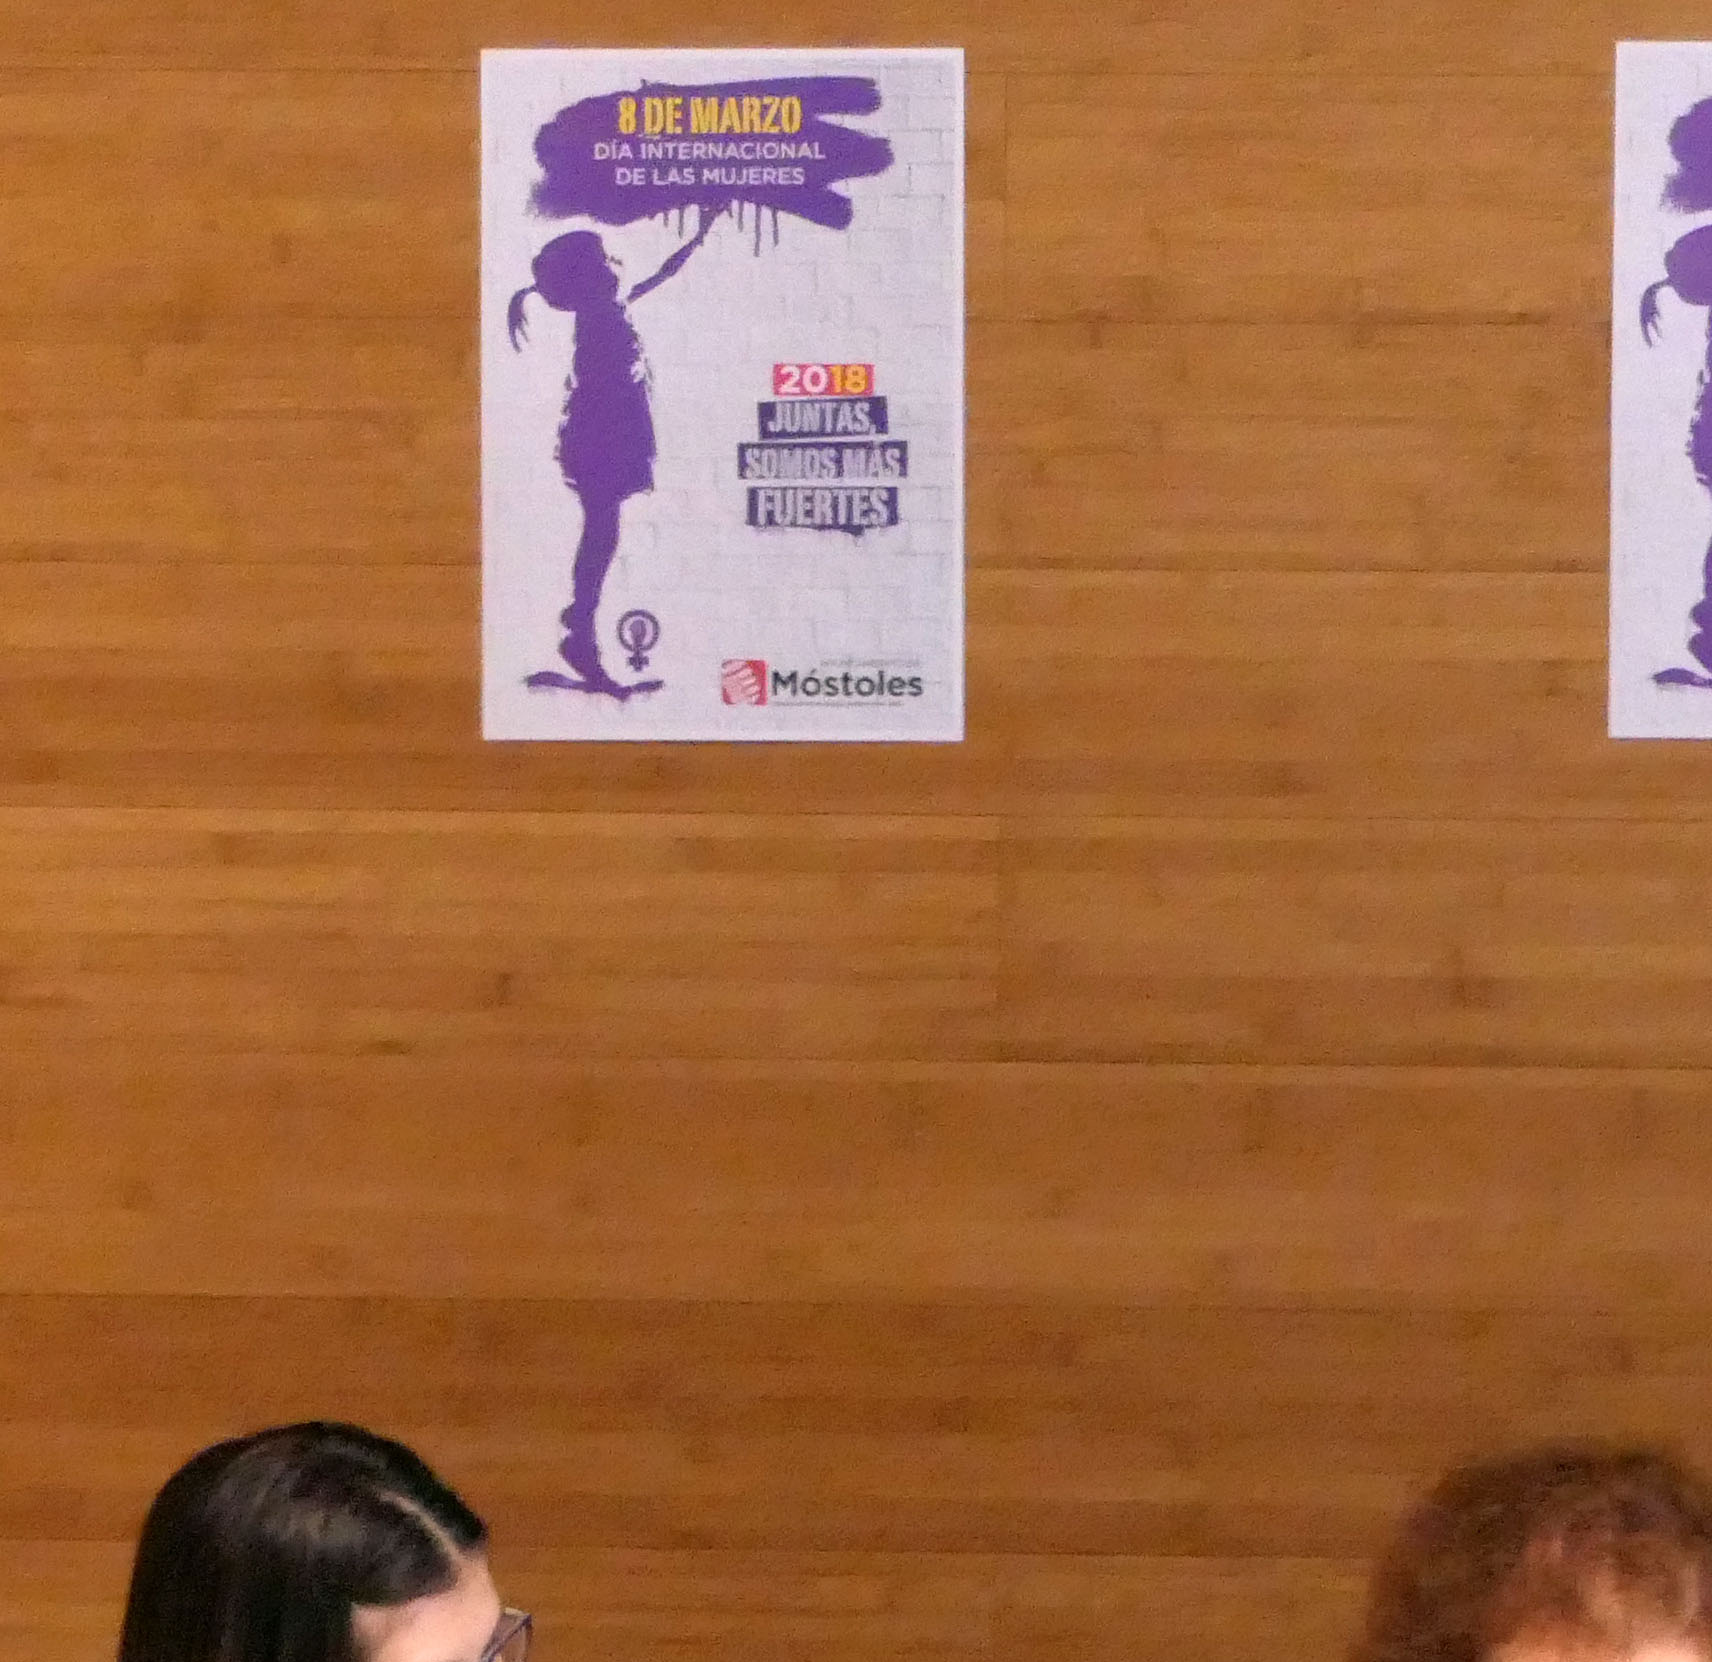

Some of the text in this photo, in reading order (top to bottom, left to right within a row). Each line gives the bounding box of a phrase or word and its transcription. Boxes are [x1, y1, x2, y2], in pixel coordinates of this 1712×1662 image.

[618, 95, 802, 134] 8 DE MARZO
[593, 139, 826, 160] DÍA INTERNACIONAL
[615, 166, 805, 186] DE LAS MUJERES
[779, 365, 869, 394] 2018
[767, 401, 876, 435] JUNTAS,
[744, 447, 837, 479] SOMOS
[757, 487, 889, 526] FUERTES
[771, 668, 923, 697] Móstoles
